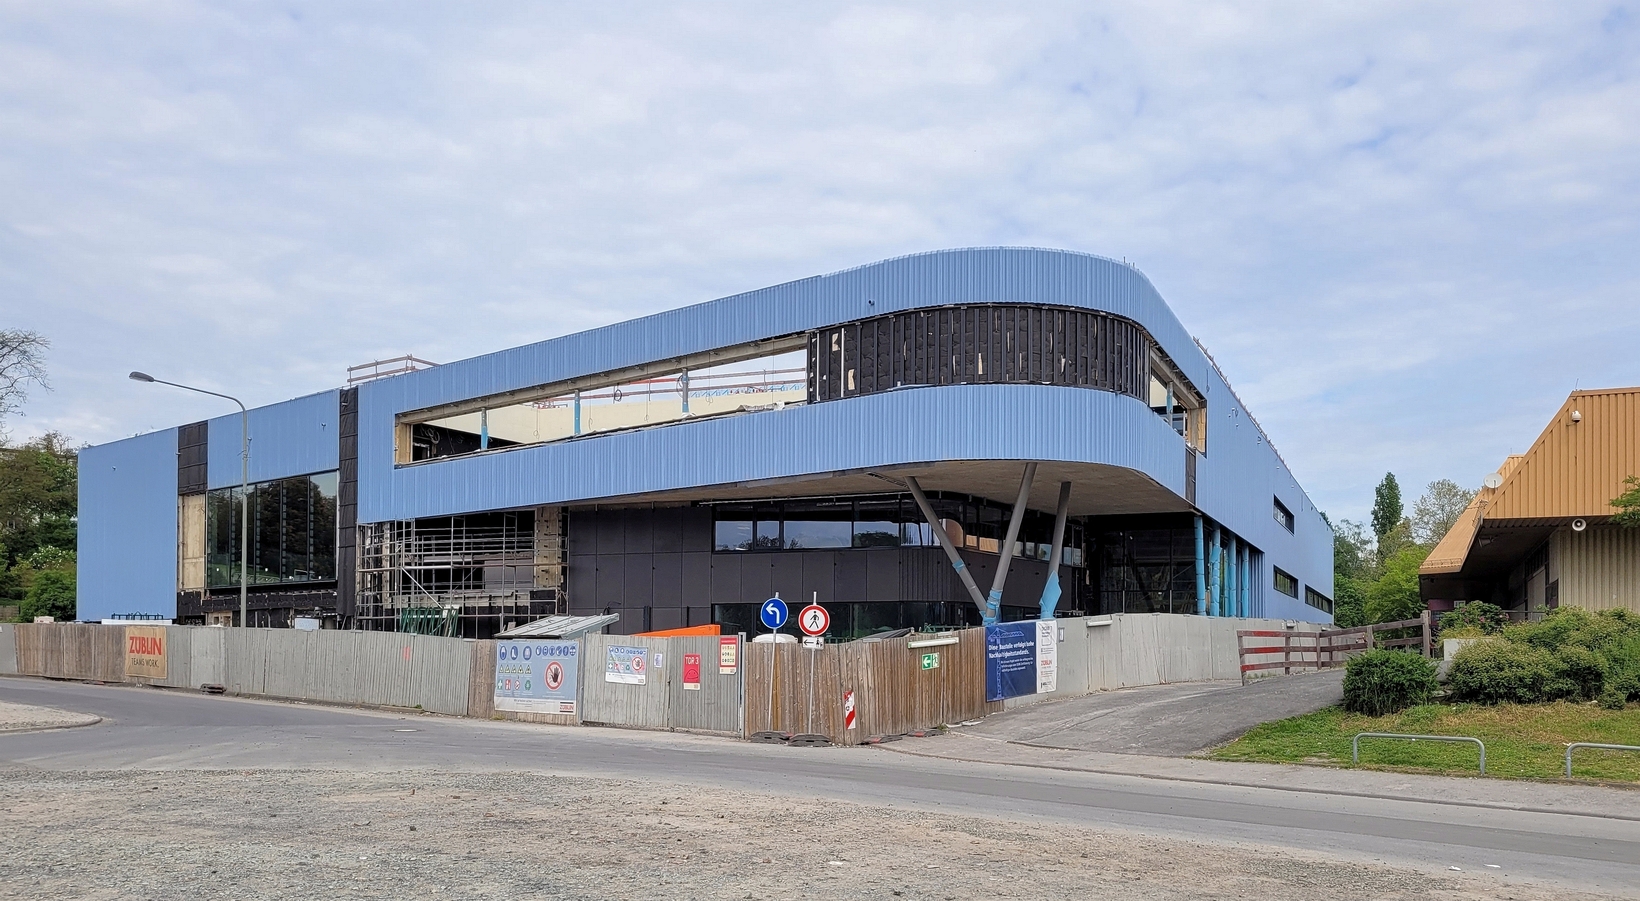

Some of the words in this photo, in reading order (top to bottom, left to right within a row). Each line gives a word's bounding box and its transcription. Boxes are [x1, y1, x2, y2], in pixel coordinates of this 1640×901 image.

[131, 657, 145, 666] TEAMS
[685, 656, 694, 665] TOR
[695, 657, 699, 665] 3
